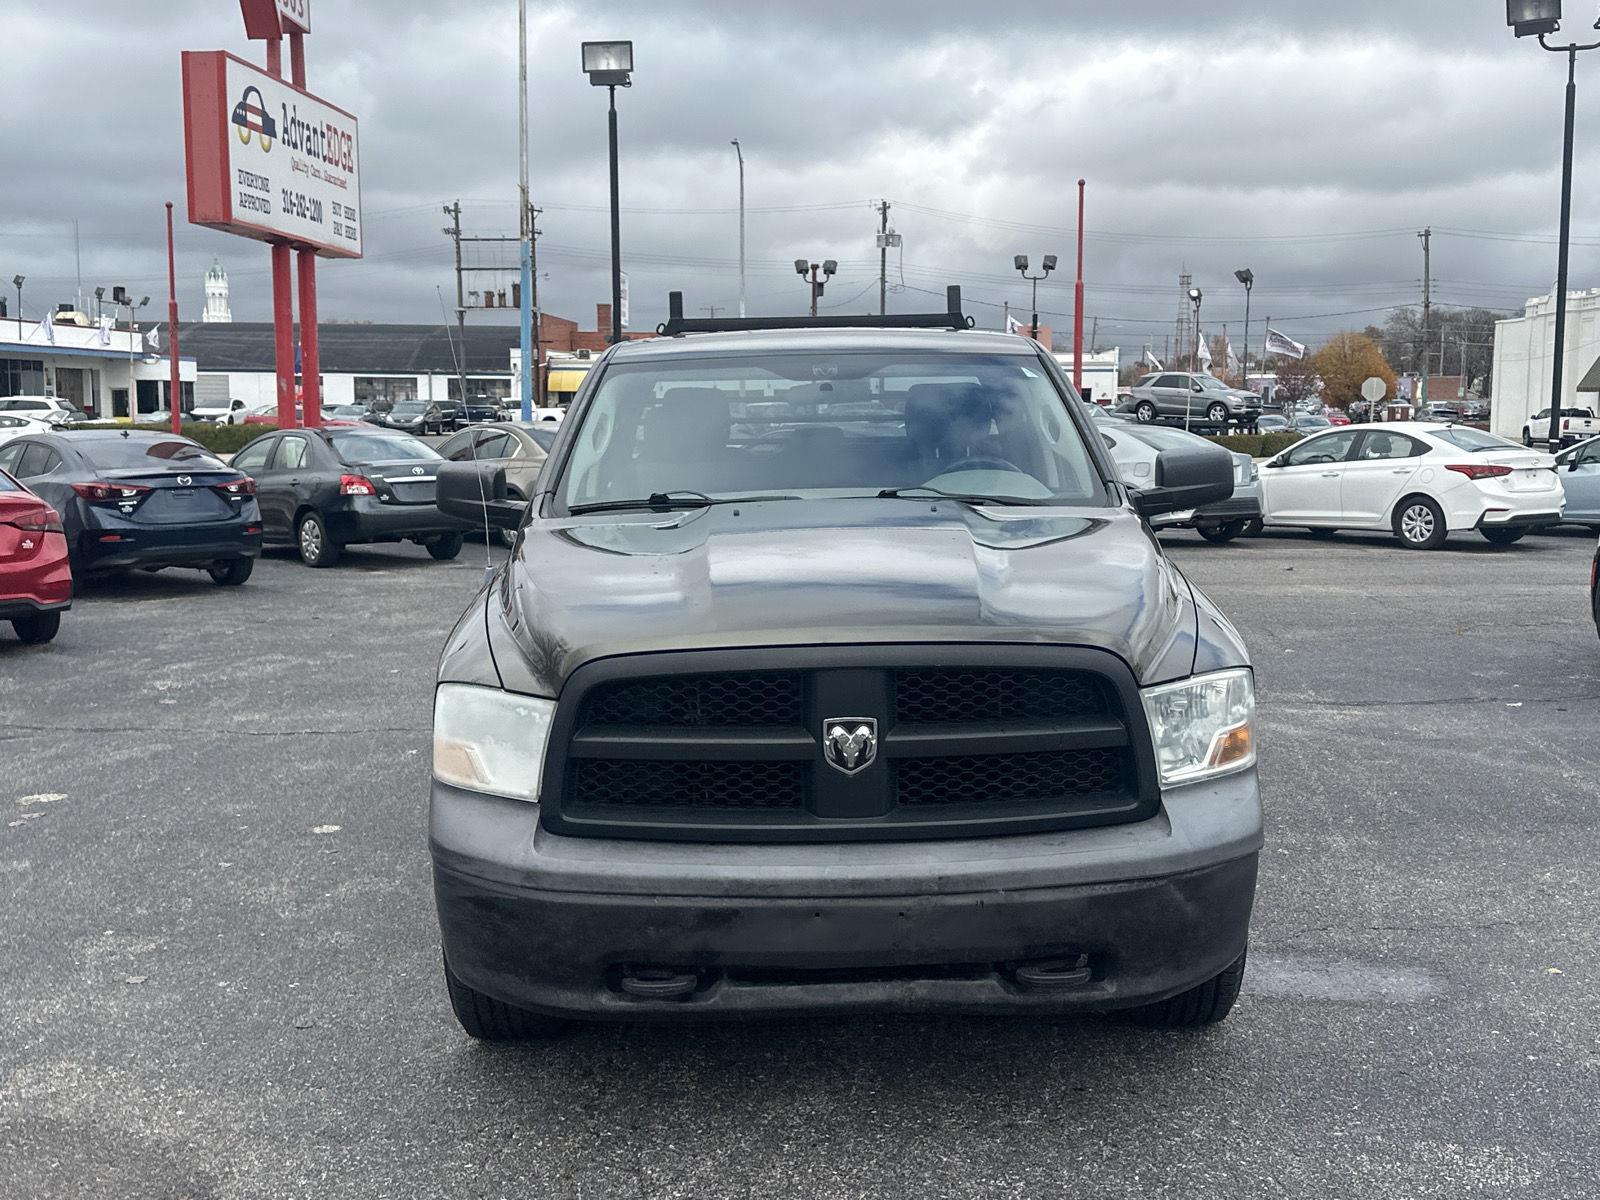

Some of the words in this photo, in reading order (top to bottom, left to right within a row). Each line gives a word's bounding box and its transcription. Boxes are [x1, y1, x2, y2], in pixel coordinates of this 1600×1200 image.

[282, 102, 354, 174] AdvantEDGE
[238, 168, 270, 193] EVERYONE
[239, 192, 271, 215] APPROVED
